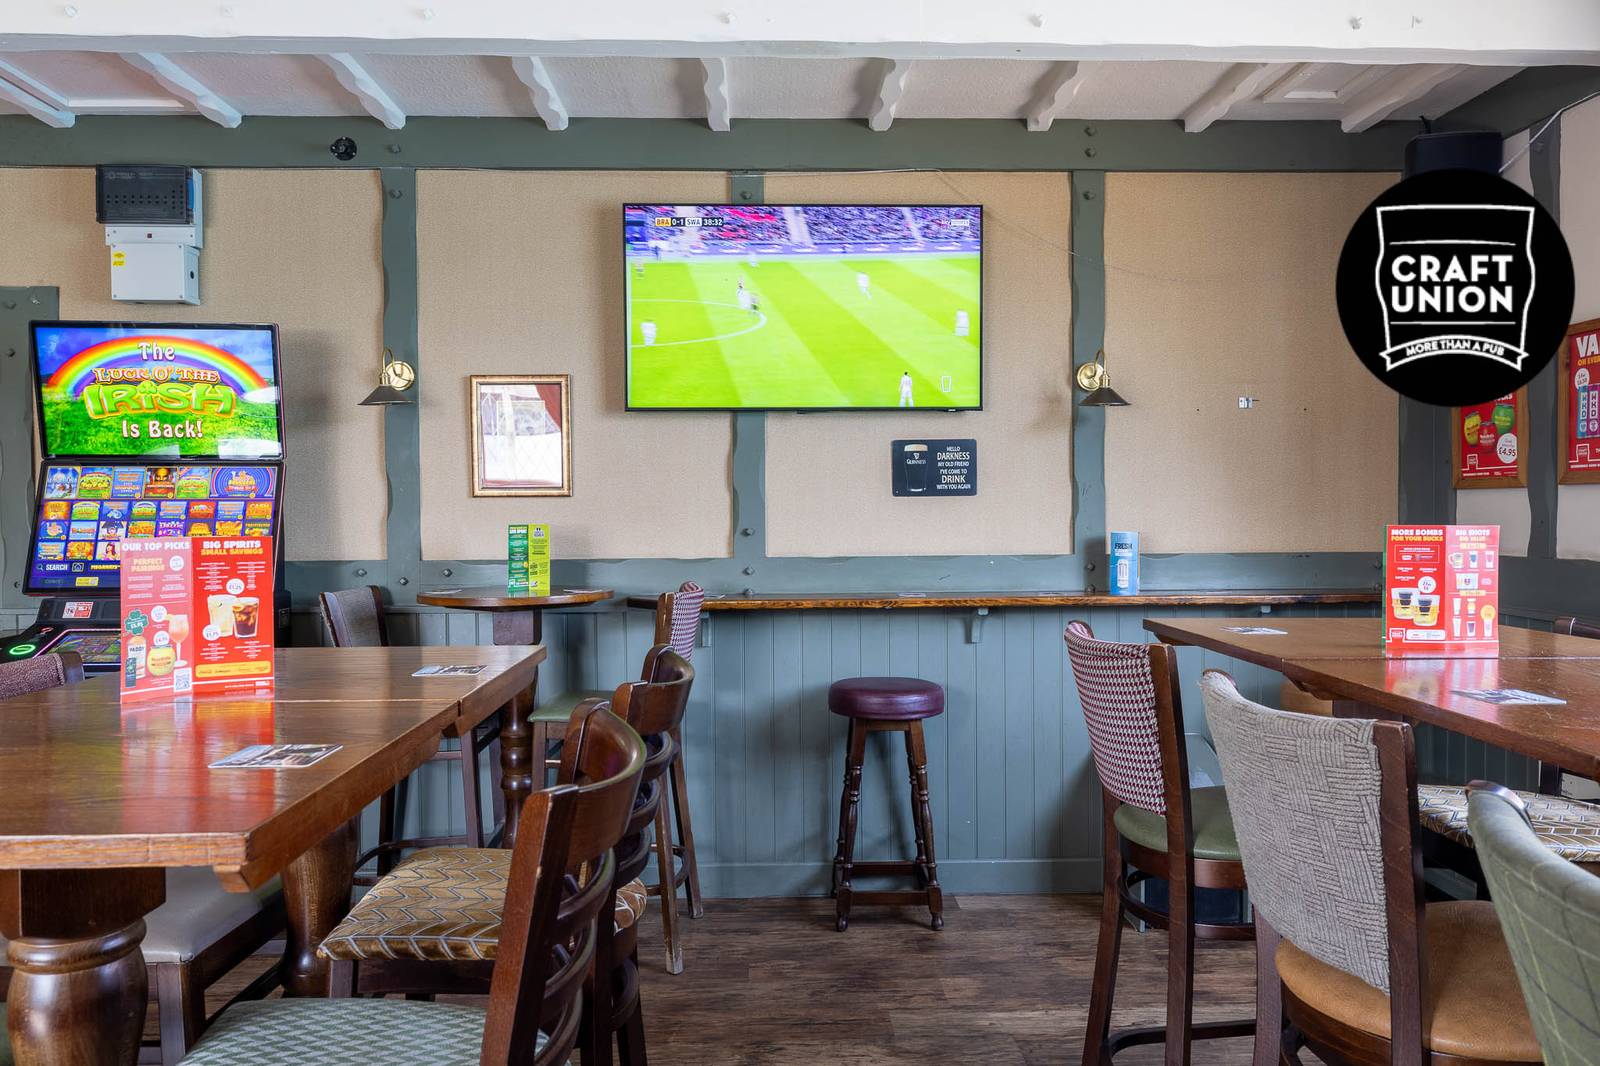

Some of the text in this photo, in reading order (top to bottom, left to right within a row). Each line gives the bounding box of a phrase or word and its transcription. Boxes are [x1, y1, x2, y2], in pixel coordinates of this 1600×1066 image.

[656, 218, 723, 226] BRA 0-1 SWA 38:32
[138, 342, 175, 361] The
[93, 367, 149, 384] LUCK
[176, 368, 220, 384] THE
[122, 420, 203, 438] Is Back!
[1498, 446, 1516, 457] £4.95
[936, 452, 970, 461] DARKNESS
[941, 475, 966, 483] DRINK
[122, 541, 191, 551] OUR TOP PICKS
[203, 540, 261, 549] BIG SPIRITS
[201, 548, 228, 556] SMALL
